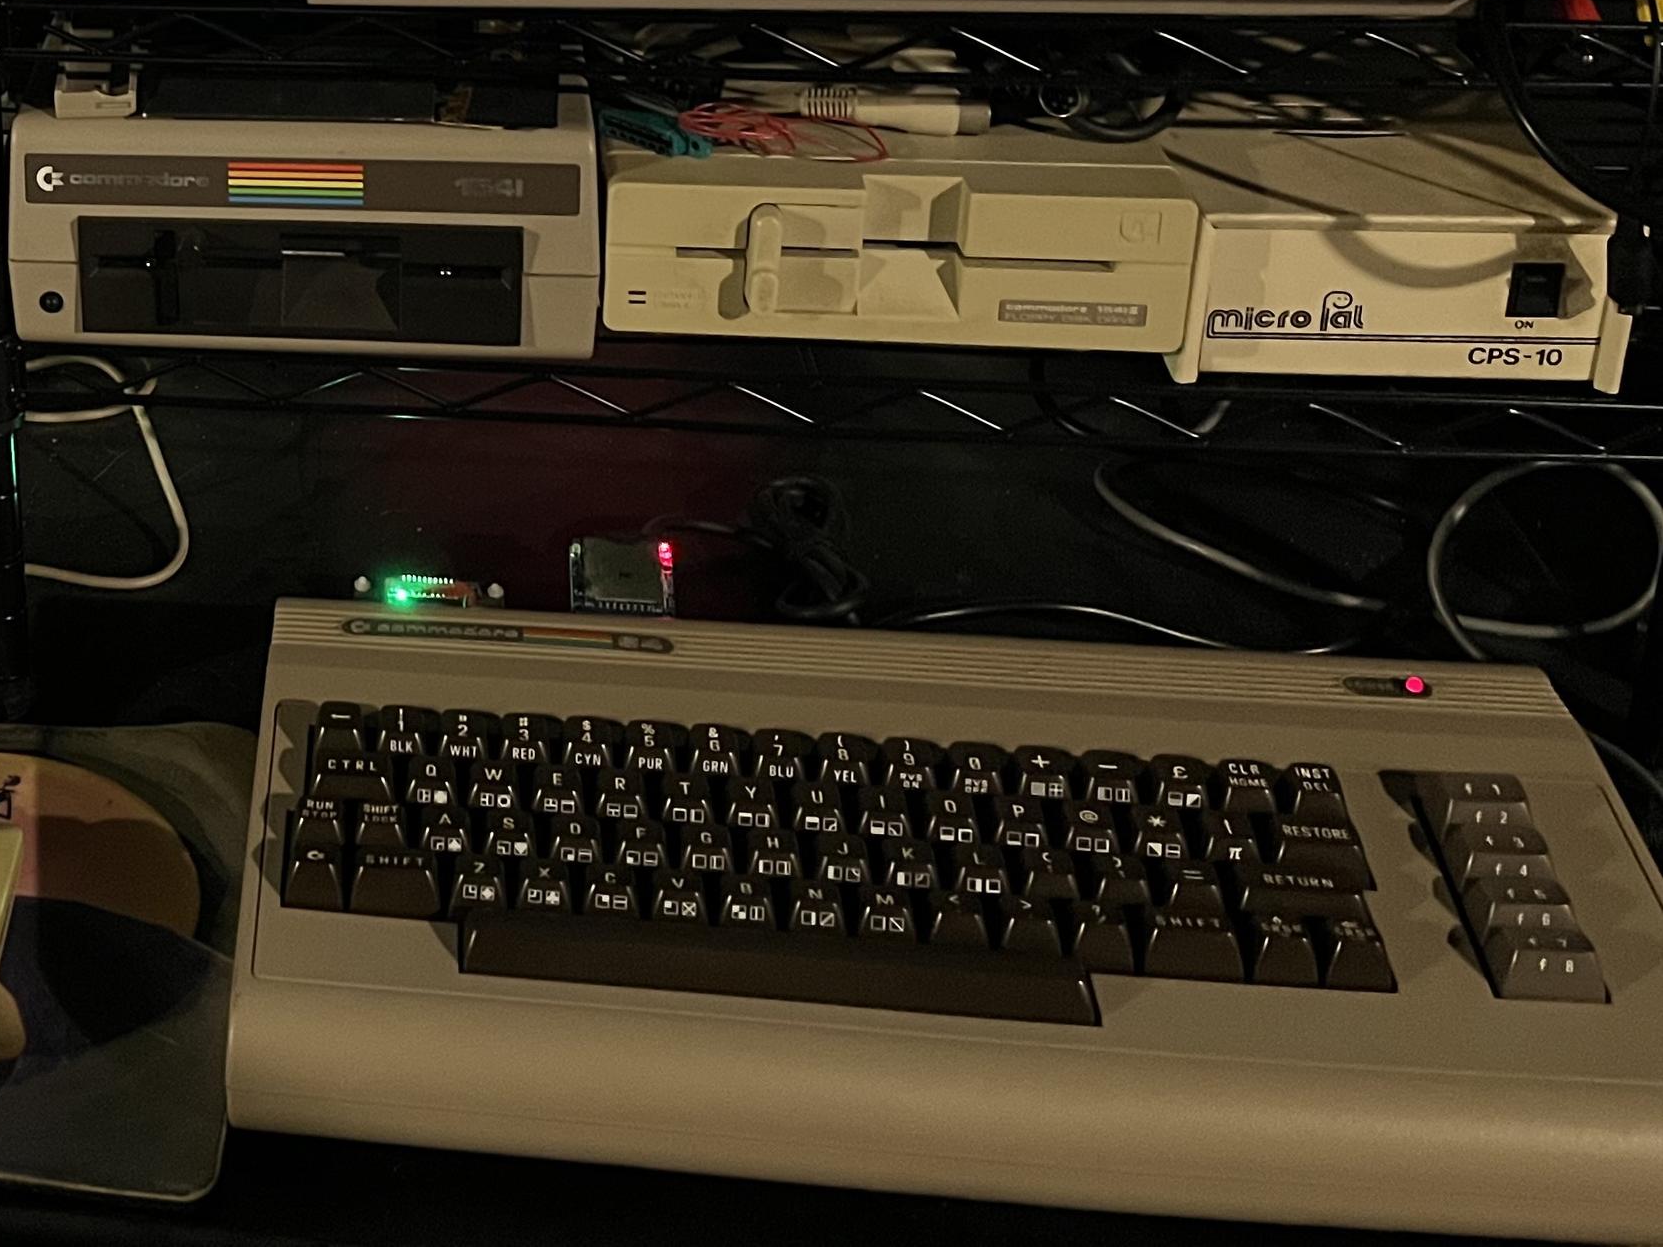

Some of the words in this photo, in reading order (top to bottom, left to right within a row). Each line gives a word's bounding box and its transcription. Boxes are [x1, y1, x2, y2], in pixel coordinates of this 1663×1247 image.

[1515, 320, 1535, 331] ON
[1467, 346, 1564, 367] CPS-10
[456, 724, 469, 738] 2
[518, 728, 530, 743] 3
[581, 731, 593, 744] 4
[389, 738, 415, 754] BLK
[449, 744, 478, 759] WHT
[511, 747, 537, 762] RED
[574, 752, 602, 767] CYN
[902, 752, 915, 766] 9
[326, 758, 379, 773] CTRL
[425, 763, 438, 778] Q
[638, 756, 664, 771] PUR
[702, 759, 730, 775] GRN
[1227, 762, 1261, 776] CLR
[483, 767, 504, 782] W
[552, 771, 563, 787] E
[768, 764, 795, 779] BLU
[833, 769, 858, 784] YEL
[1294, 766, 1331, 780] INST
[614, 776, 627, 791] R
[678, 781, 691, 796] T
[744, 785, 758, 800] Y
[810, 789, 824, 805] U
[305, 798, 336, 811] RUN
[362, 803, 400, 815] SHIFT
[1011, 803, 1026, 819] P
[502, 816, 515, 831] S
[569, 822, 582, 836] D
[634, 826, 648, 840] F
[699, 831, 713, 845] G
[1280, 822, 1352, 841] RESTORE
[765, 835, 781, 850] H
[364, 853, 425, 868] SHIFT
[900, 846, 915, 861] K
[603, 871, 617, 885] C
[670, 876, 686, 890] V
[1261, 871, 1336, 890] RETURN
[807, 887, 824, 901] N
[874, 892, 896, 907] M
